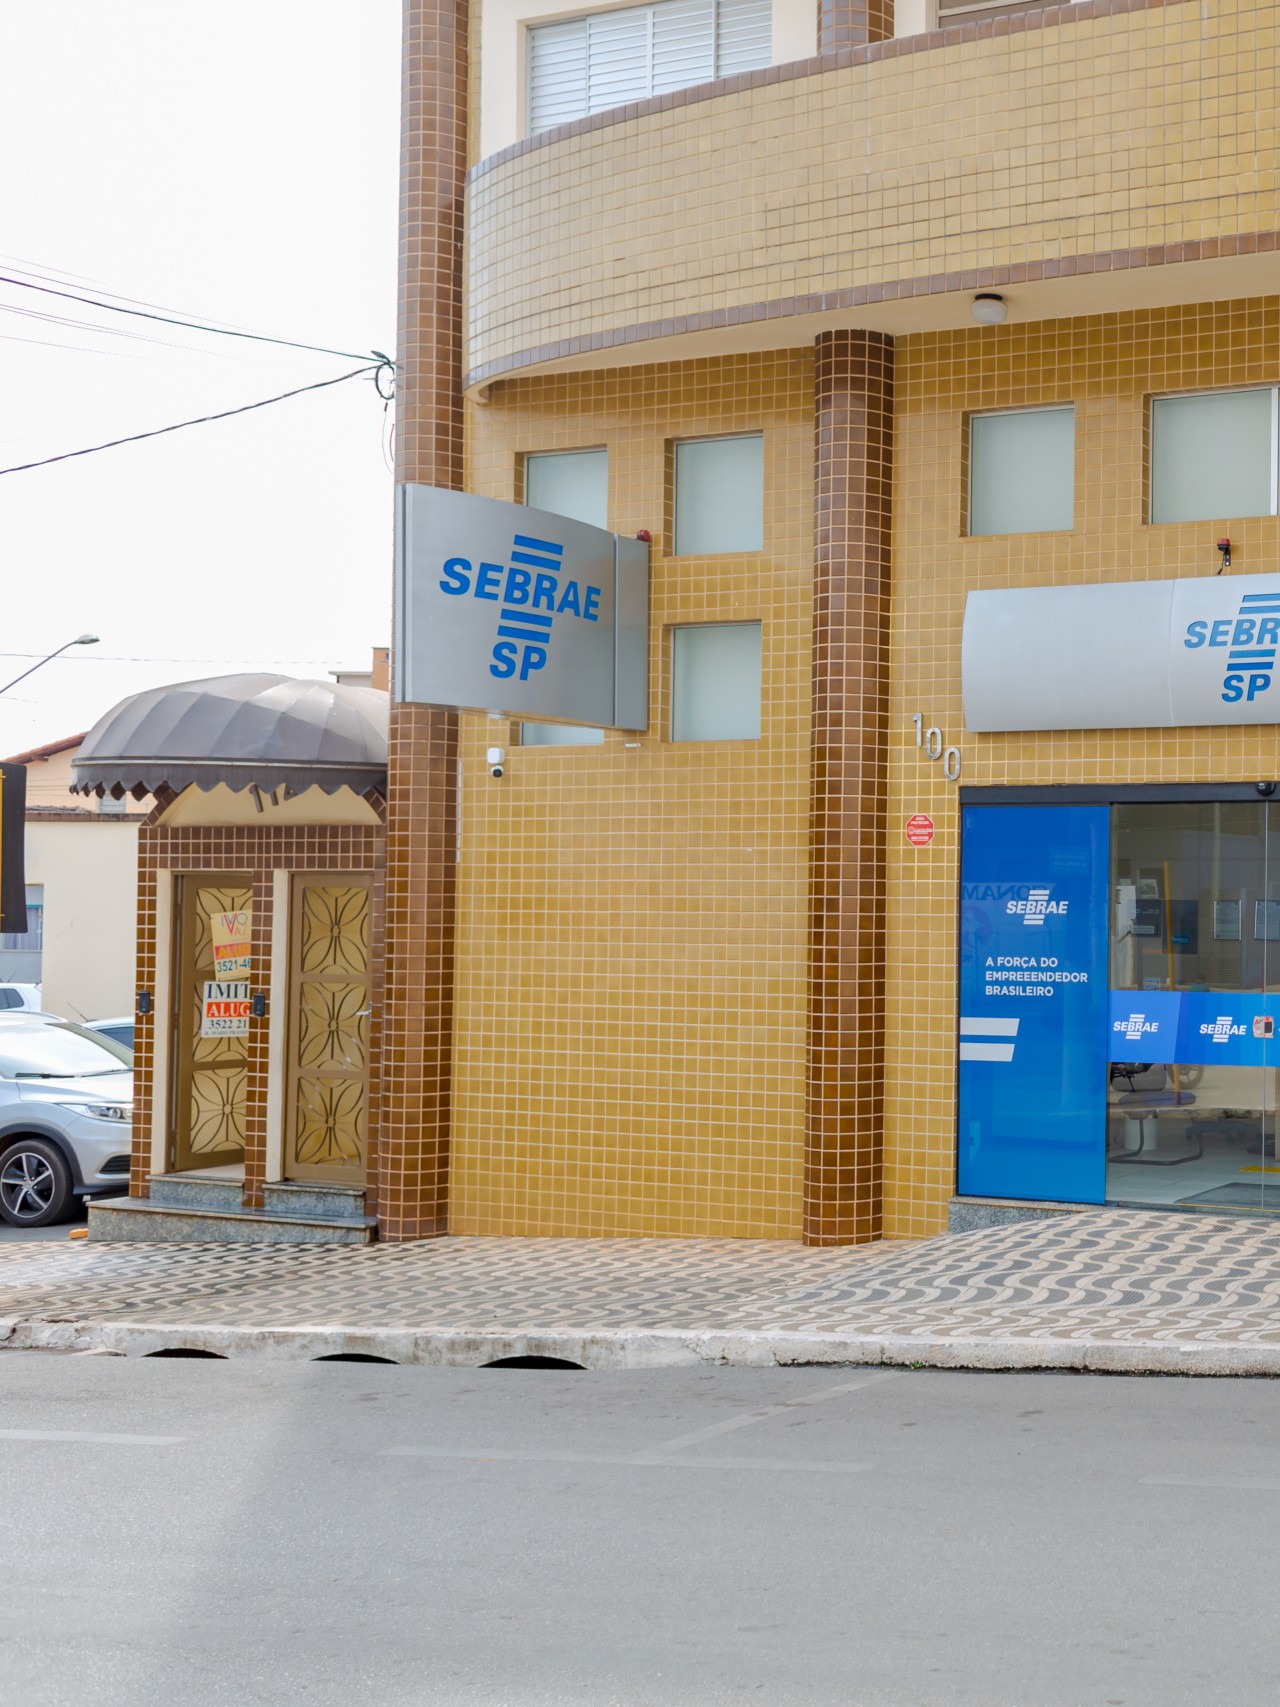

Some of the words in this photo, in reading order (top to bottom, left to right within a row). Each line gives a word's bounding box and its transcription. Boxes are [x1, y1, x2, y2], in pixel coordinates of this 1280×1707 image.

[439, 557, 601, 622] SEBRAE
[489, 642, 547, 681] SP
[1221, 673, 1271, 703] SP
[912, 712, 961, 781] 100
[1006, 901, 1069, 914] SEBRAE
[985, 957, 994, 967] A
[997, 957, 1037, 969] FORÇA
[1040, 957, 1058, 967] DO
[985, 971, 1088, 983] EMPREEENDEDOR
[985, 985, 1054, 997] BRASILEIRO
[208, 1019, 233, 1029] 3522
[1113, 1021, 1159, 1033] SEBRAE
[1199, 1024, 1247, 1035] SEBRAE
